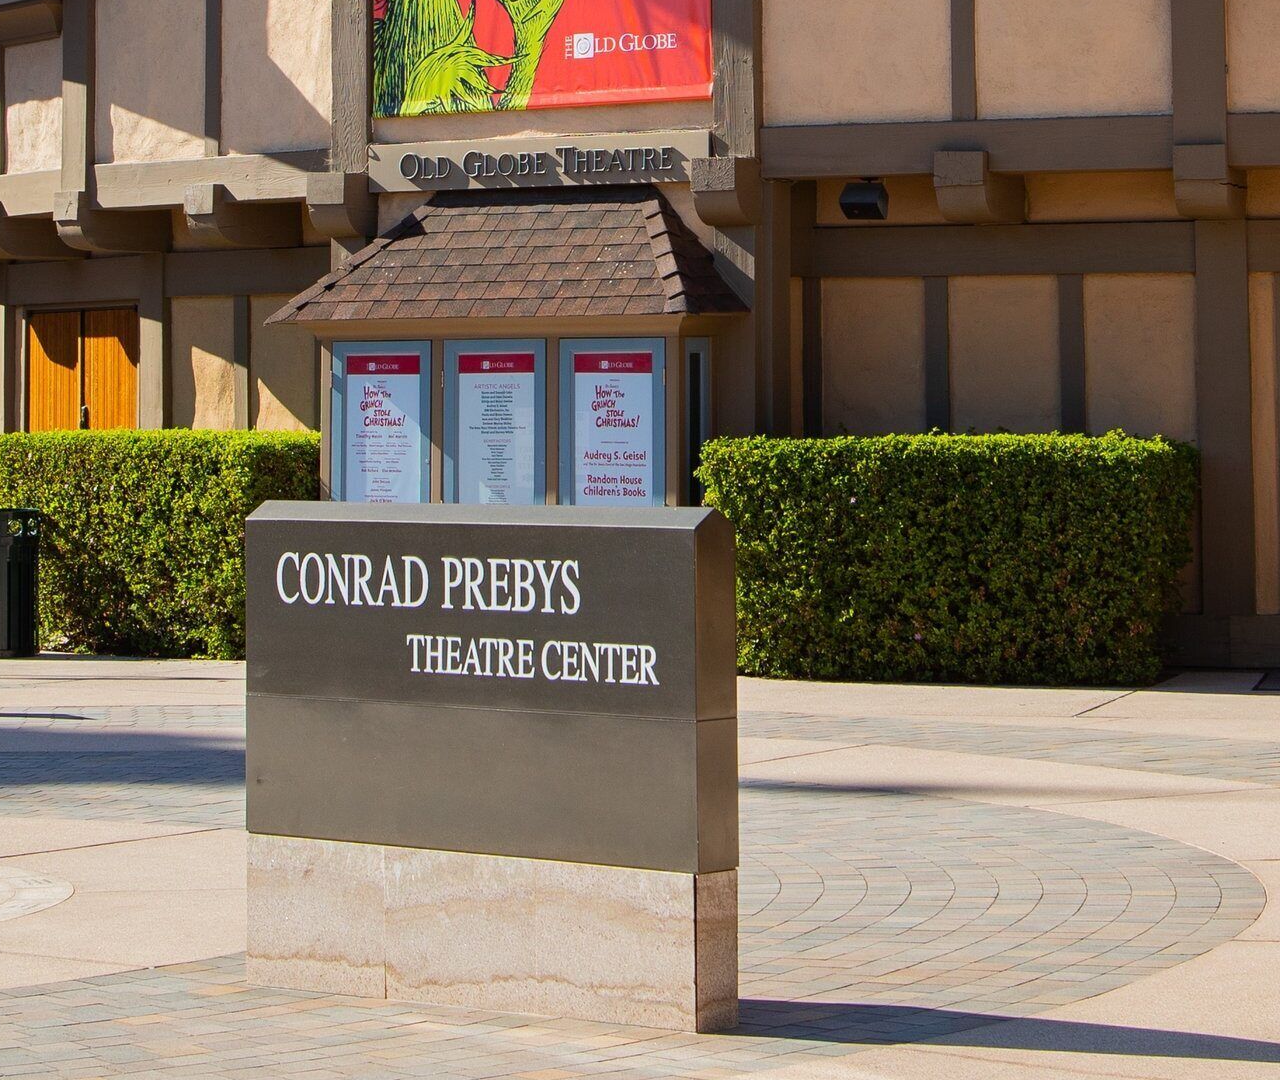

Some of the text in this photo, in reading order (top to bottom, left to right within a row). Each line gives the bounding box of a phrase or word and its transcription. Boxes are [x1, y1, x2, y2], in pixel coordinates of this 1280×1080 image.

[564, 33, 678, 60] THE OLD GLOBE
[399, 145, 674, 181] OLD GLOBE THEATRE
[364, 386, 380, 400] HOW
[595, 385, 612, 400] HOW
[360, 400, 384, 412] GRINCH
[592, 400, 616, 412] GRINCH
[364, 414, 406, 427] CHRISTMAS!
[596, 414, 640, 428] CHRISTMAS!
[584, 450, 646, 462] Audrey S. Geisel
[587, 474, 642, 484] Random House
[584, 486, 646, 498] Children's Books
[276, 551, 581, 615] CONRAD PREBYS
[406, 633, 660, 686] THEATRE CENTER
